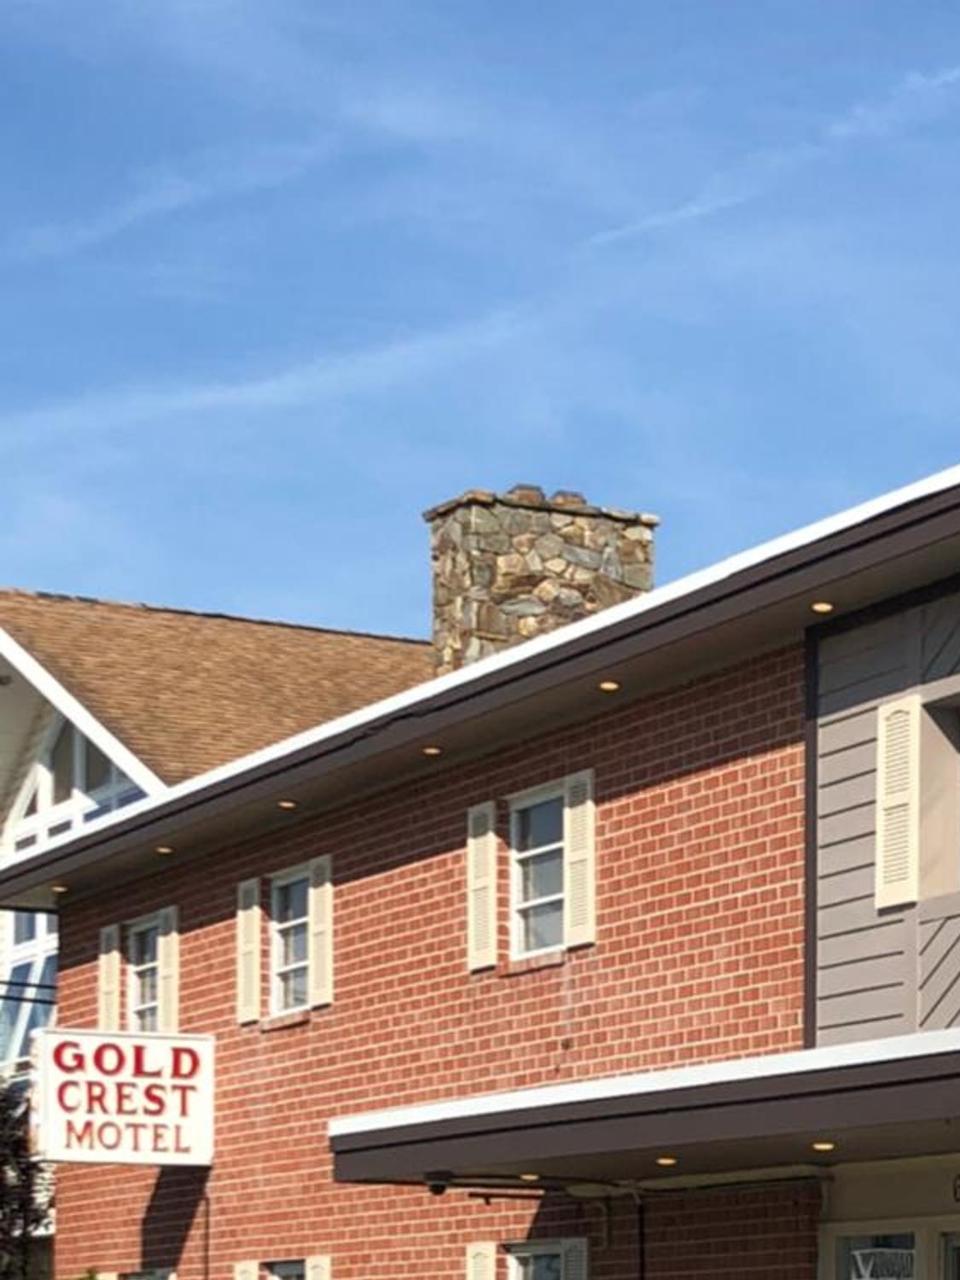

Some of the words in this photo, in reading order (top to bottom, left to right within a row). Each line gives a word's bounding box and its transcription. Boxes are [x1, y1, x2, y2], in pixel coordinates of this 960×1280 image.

[53, 1041, 200, 1079] GOLD
[57, 1080, 197, 1117] CREST
[65, 1119, 191, 1153] MOTEL
